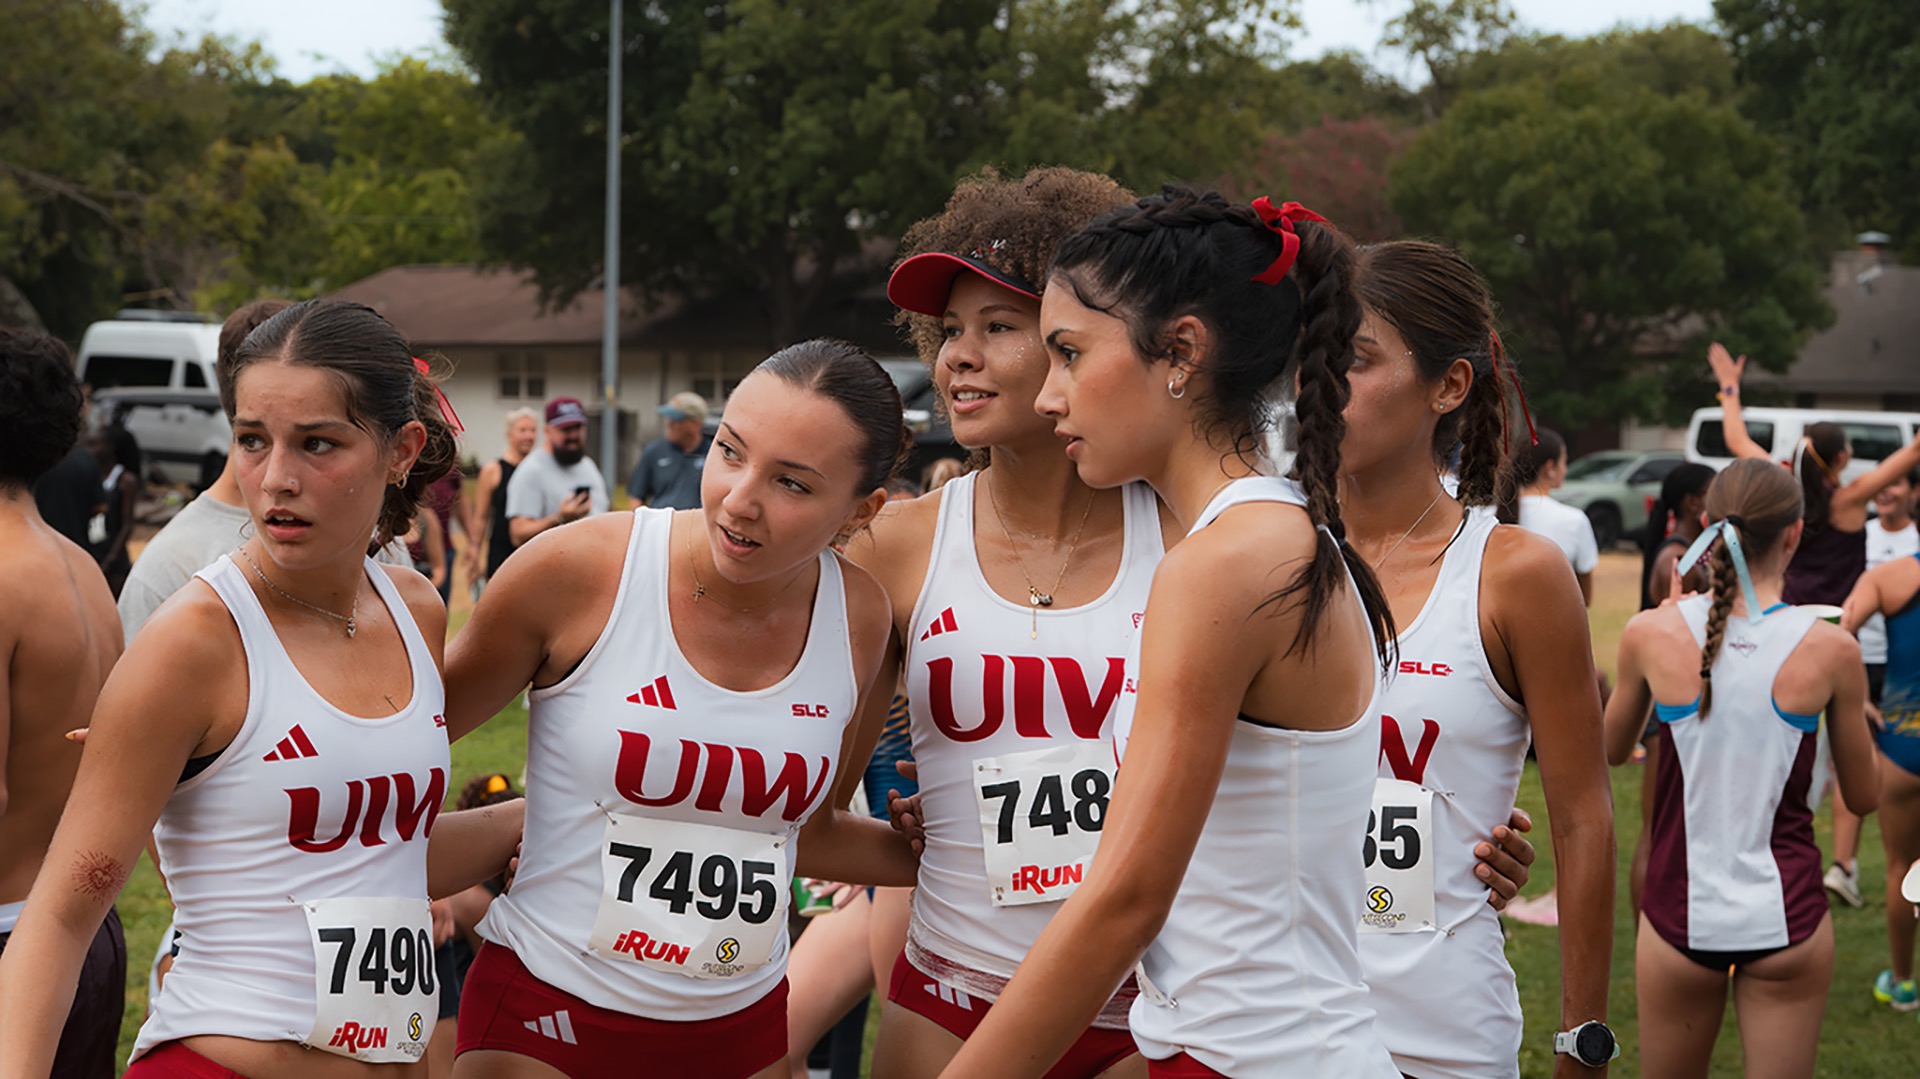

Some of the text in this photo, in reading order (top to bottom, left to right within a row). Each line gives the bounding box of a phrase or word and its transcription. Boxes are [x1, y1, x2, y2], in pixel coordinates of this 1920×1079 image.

[1398, 661, 1453, 677] SLC
[791, 703, 829, 718] SLC
[284, 768, 445, 853] UIW
[614, 729, 830, 823] UIW
[981, 769, 1118, 844] 748
[609, 841, 778, 925] 7495
[318, 927, 434, 996] 7490
[612, 929, 691, 965] iRUN
[328, 1021, 388, 1054] iRUN
